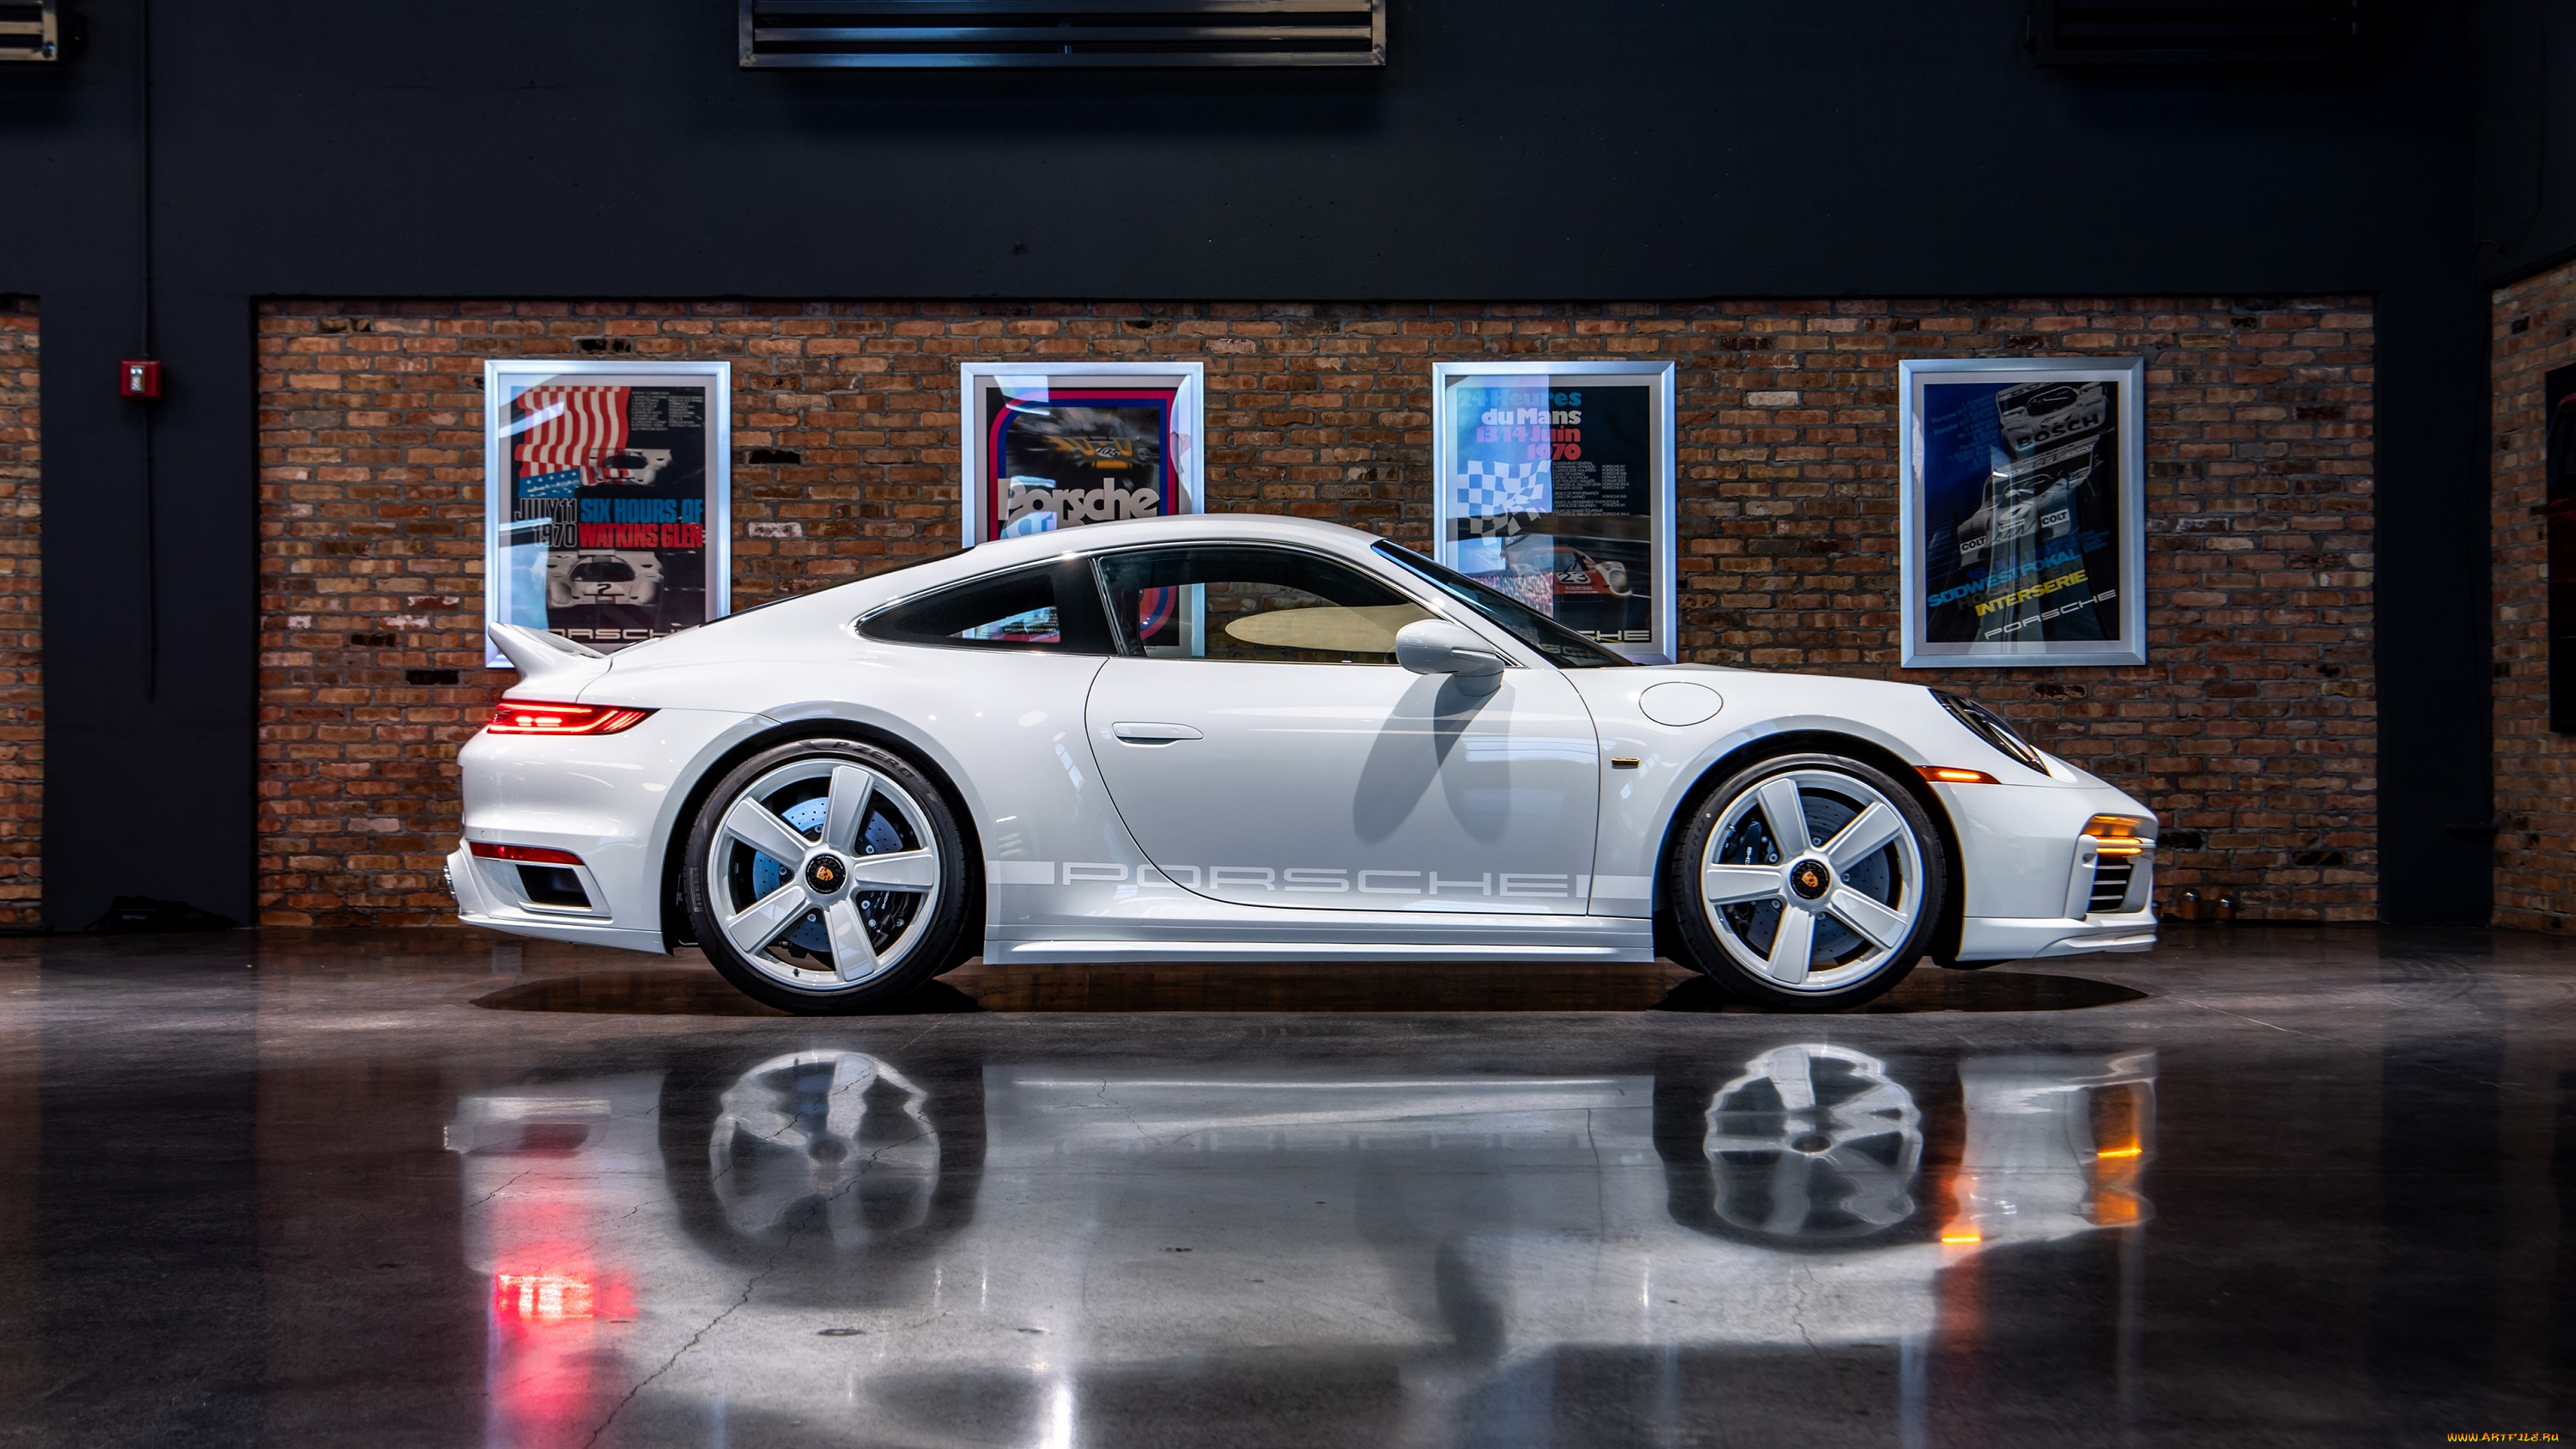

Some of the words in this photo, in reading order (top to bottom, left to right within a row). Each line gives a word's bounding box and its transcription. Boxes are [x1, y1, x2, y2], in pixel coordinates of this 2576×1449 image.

[1490, 391, 1582, 407] Heures
[1481, 408, 1514, 425] du
[1516, 408, 1582, 425] Mans
[1529, 425, 1581, 442] Juin
[2016, 413, 2099, 449] BOSCH
[1096, 447, 1120, 457] 105
[1528, 443, 1582, 460] 1970
[998, 477, 1160, 521] Porsche
[560, 498, 578, 523] 11
[580, 498, 611, 523] SIX
[614, 498, 677, 523] HOURS
[681, 498, 703, 523] OF
[2041, 511, 2068, 526] COLT
[532, 523, 578, 548] 1970
[578, 523, 659, 548] WATKINS
[660, 523, 703, 548] GLEN
[1961, 537, 1986, 551] COLT
[1558, 572, 1589, 583] 23
[597, 583, 612, 595] 2
[1975, 569, 2089, 618] INTERSERIE
[1984, 588, 2117, 640] PORSCHE
[853, 745, 915, 779] ZERO
[1062, 861, 1570, 898] PORSCHE
